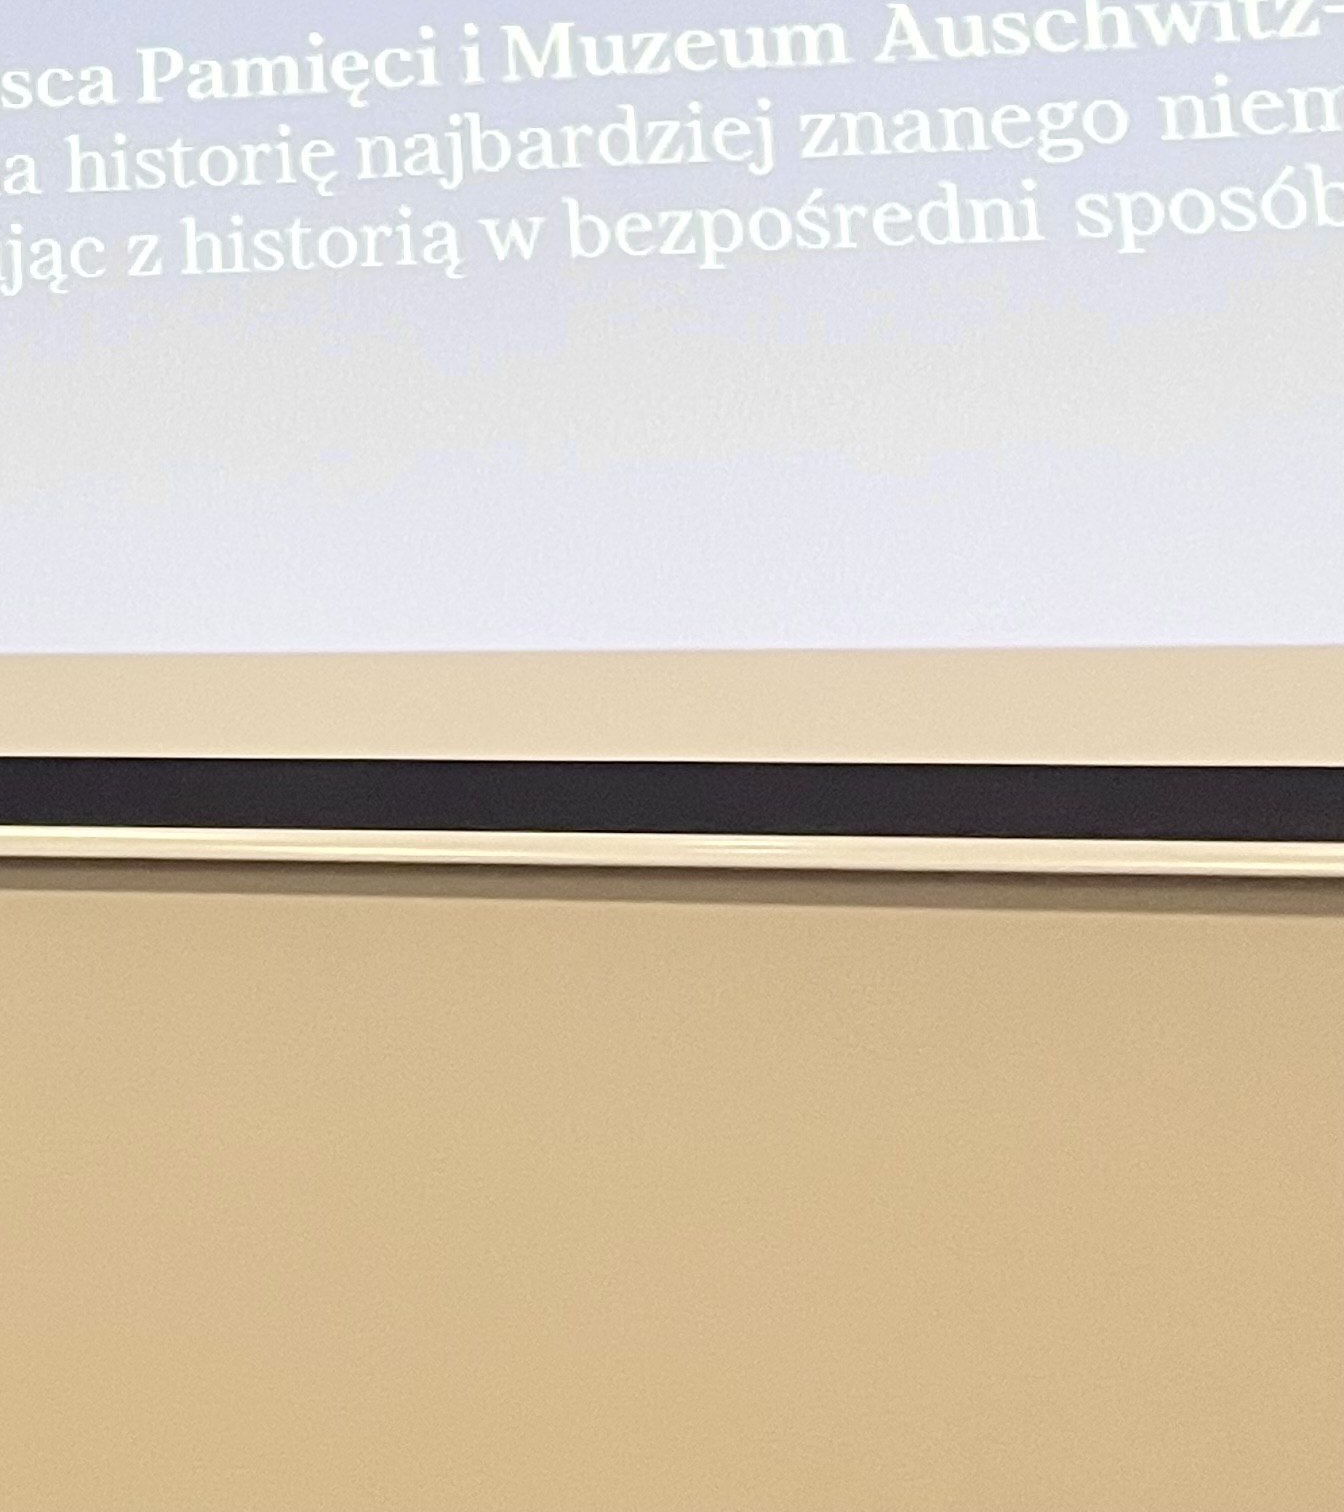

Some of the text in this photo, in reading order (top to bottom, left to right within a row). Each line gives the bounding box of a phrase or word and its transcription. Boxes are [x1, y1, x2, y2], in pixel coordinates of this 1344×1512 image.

[135, 25, 441, 109] Pamięci
[460, 22, 485, 85] i
[500, 21, 854, 83] Muzeum
[65, 123, 338, 197] historię
[355, 97, 775, 190] najbardziej
[799, 99, 1130, 164] znanego
[127, 234, 162, 277] z
[180, 204, 464, 280] historią
[478, 216, 546, 262] w
[561, 177, 1046, 270] bezpośredni
